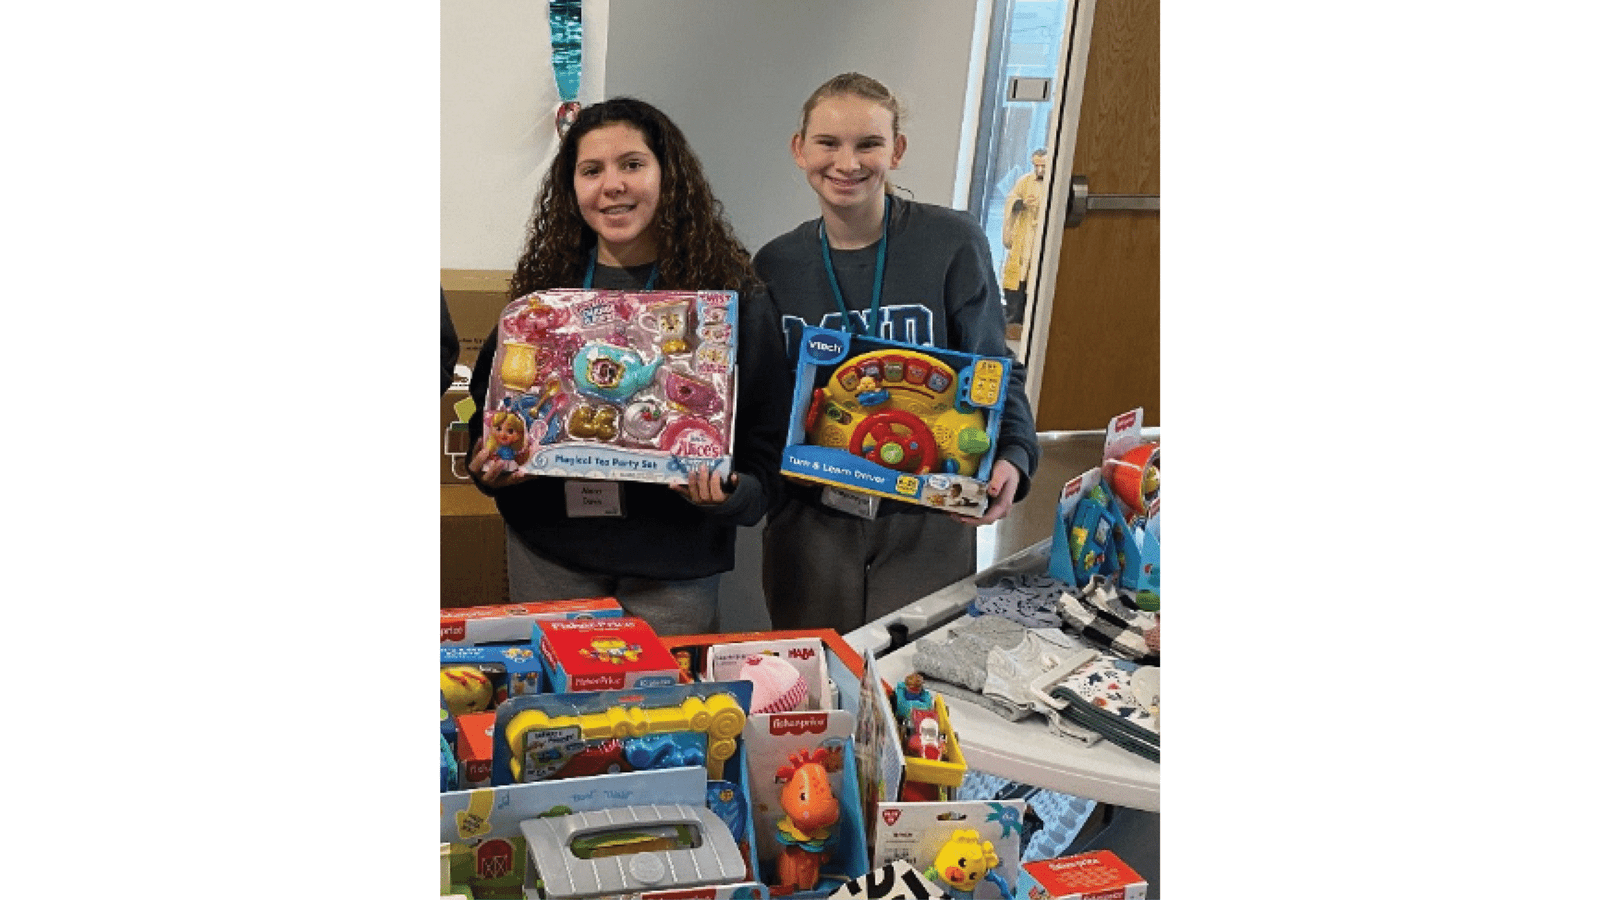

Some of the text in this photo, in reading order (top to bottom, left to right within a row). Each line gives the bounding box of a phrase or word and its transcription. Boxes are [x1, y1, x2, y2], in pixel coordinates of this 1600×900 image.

[555, 454, 658, 470] Magical Tea Party Set
[823, 464, 852, 476] Learn
[854, 470, 886, 484] Driver
[787, 648, 815, 660] HABA
